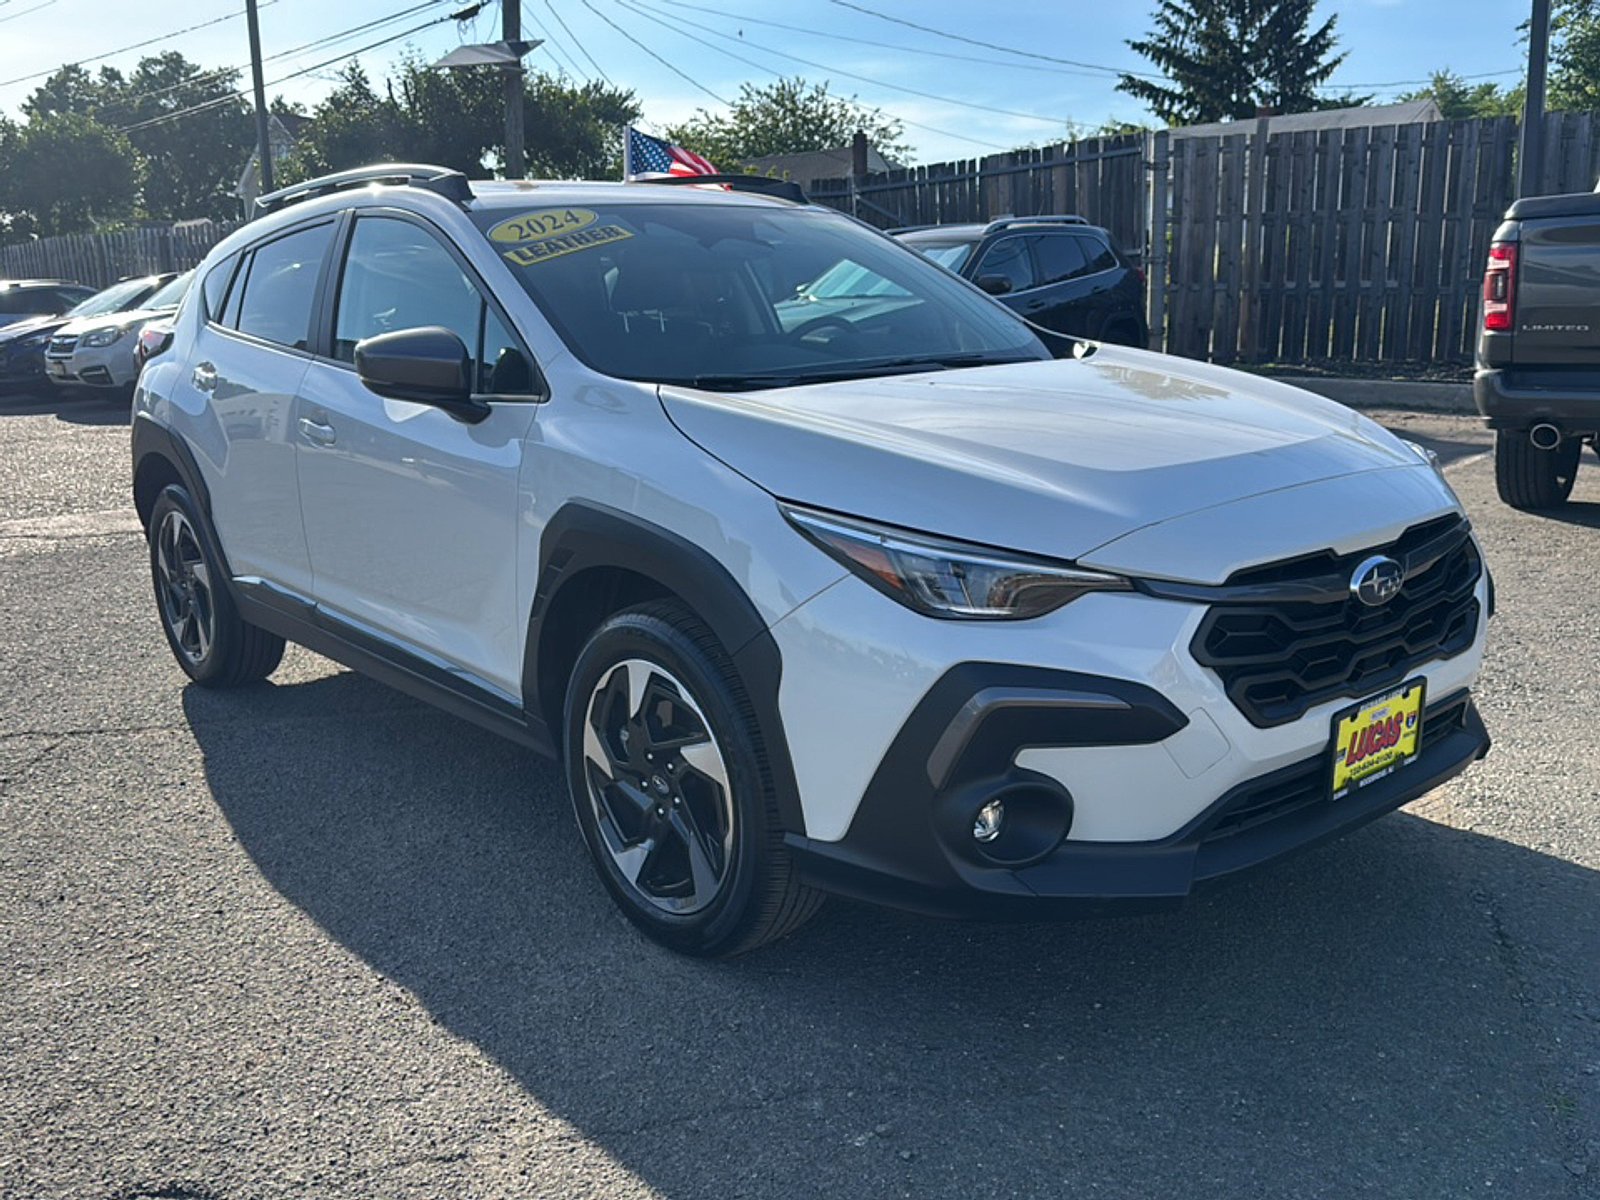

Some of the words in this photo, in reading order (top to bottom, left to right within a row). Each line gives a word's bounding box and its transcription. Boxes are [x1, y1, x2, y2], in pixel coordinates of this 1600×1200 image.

[508, 208, 580, 240] 2024
[513, 225, 622, 261] LEATHER
[1345, 711, 1403, 767] LUCAS
